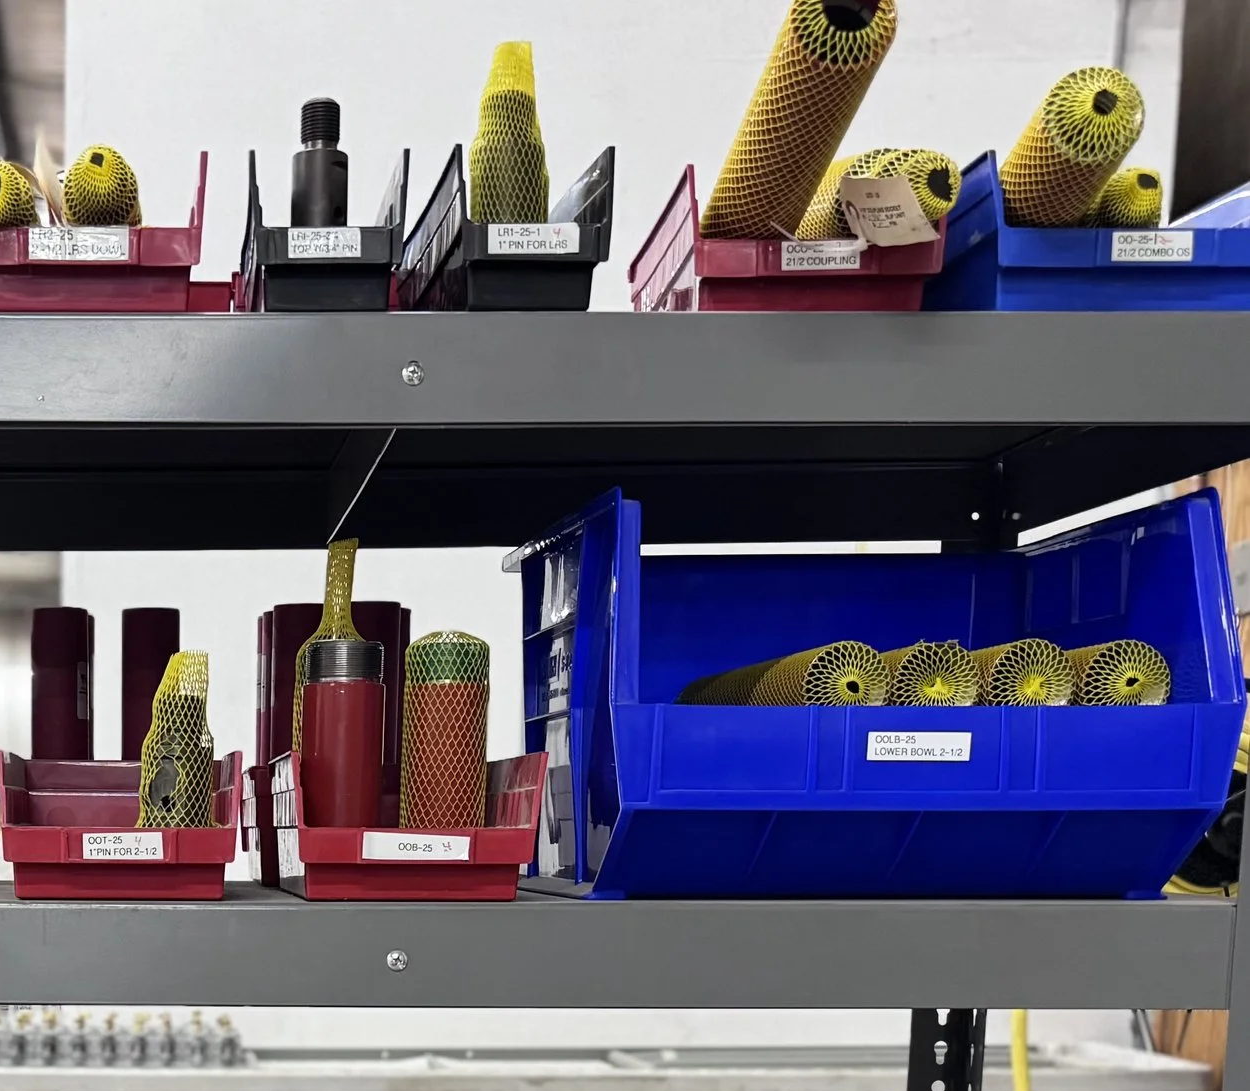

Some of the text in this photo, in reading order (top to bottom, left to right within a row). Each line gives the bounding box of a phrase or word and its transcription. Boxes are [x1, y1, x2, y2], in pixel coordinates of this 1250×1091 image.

[498, 227, 540, 237] LR1-25-1
[342, 244, 358, 253] PIN
[508, 240, 524, 249] PIN
[526, 240, 547, 249] FOR
[549, 240, 568, 249] LRS
[1137, 248, 1174, 257] COMBO
[1176, 248, 1190, 257] OS
[806, 256, 856, 265] COUPLING
[875, 735, 916, 744] OOLB-25
[874, 747, 963, 757] LOWER BOWL 2-1/2
[88, 836, 123, 845] OOT-25
[113, 847, 157, 856] FOR 2-1/2
[398, 842, 433, 852] OOB-25
